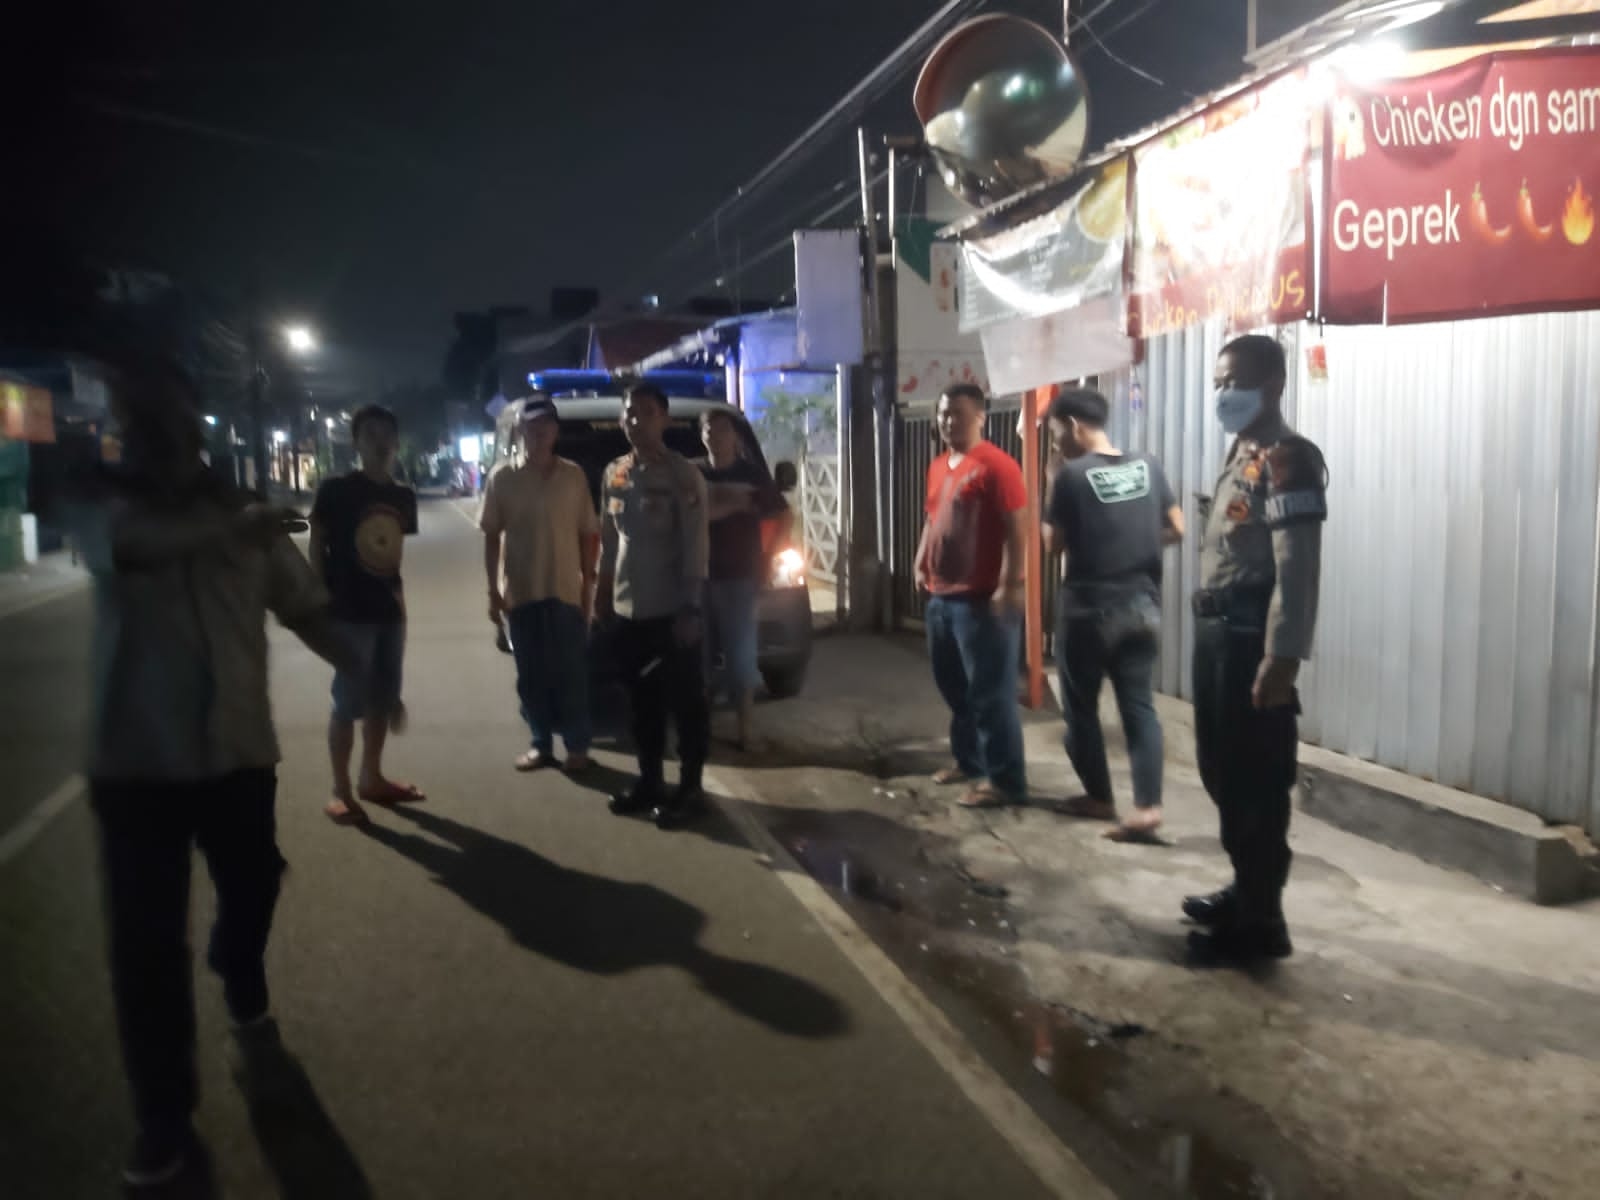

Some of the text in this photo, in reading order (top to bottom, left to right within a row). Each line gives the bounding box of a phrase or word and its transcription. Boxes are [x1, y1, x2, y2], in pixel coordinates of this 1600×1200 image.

[1371, 89, 1482, 147] Chicken
[1489, 76, 1539, 151] dgn
[1333, 188, 1461, 261] Geprek
